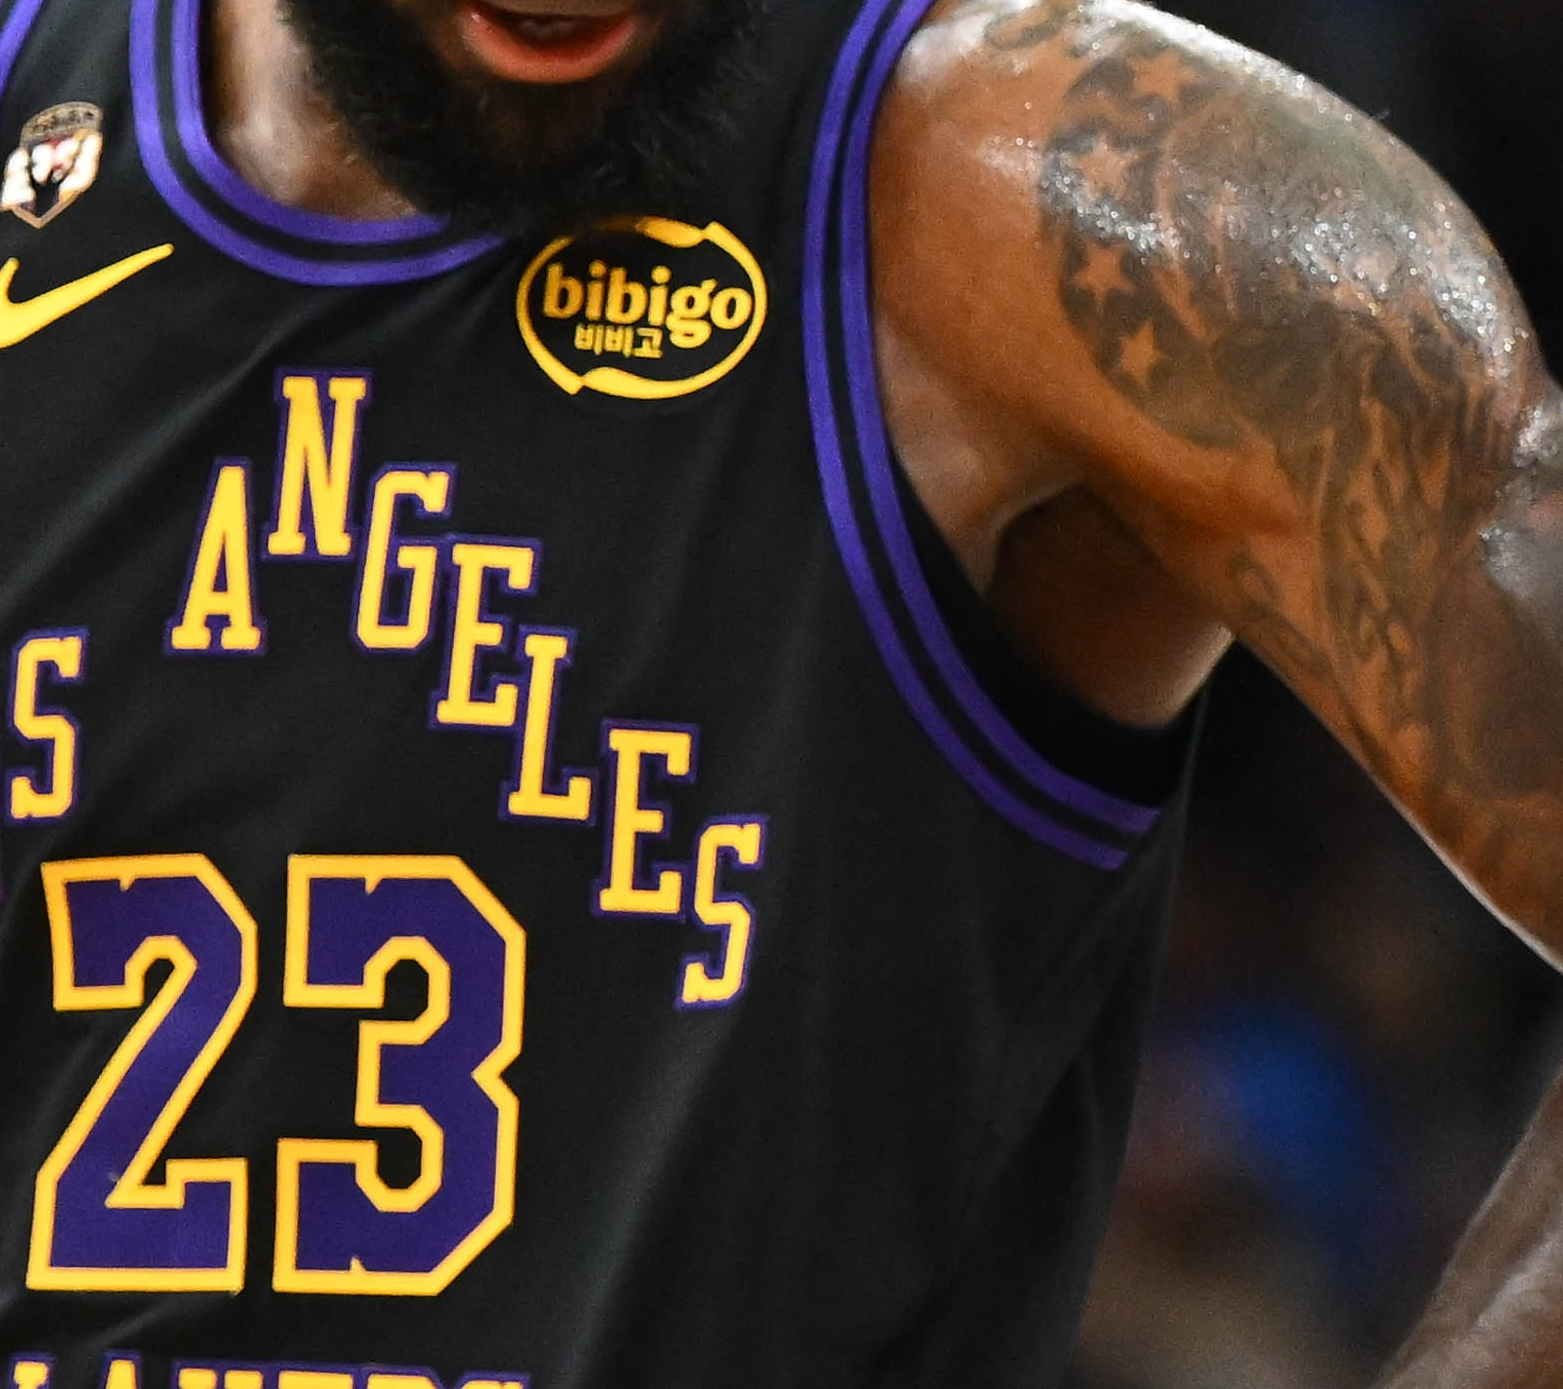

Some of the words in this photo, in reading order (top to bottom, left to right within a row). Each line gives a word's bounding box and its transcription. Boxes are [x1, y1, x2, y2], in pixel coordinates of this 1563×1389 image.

[542, 259, 753, 349] bibigo
[574, 322, 664, 359] 비비고
[170, 368, 765, 1009] ANGELES
[26, 853, 527, 1299] 23
